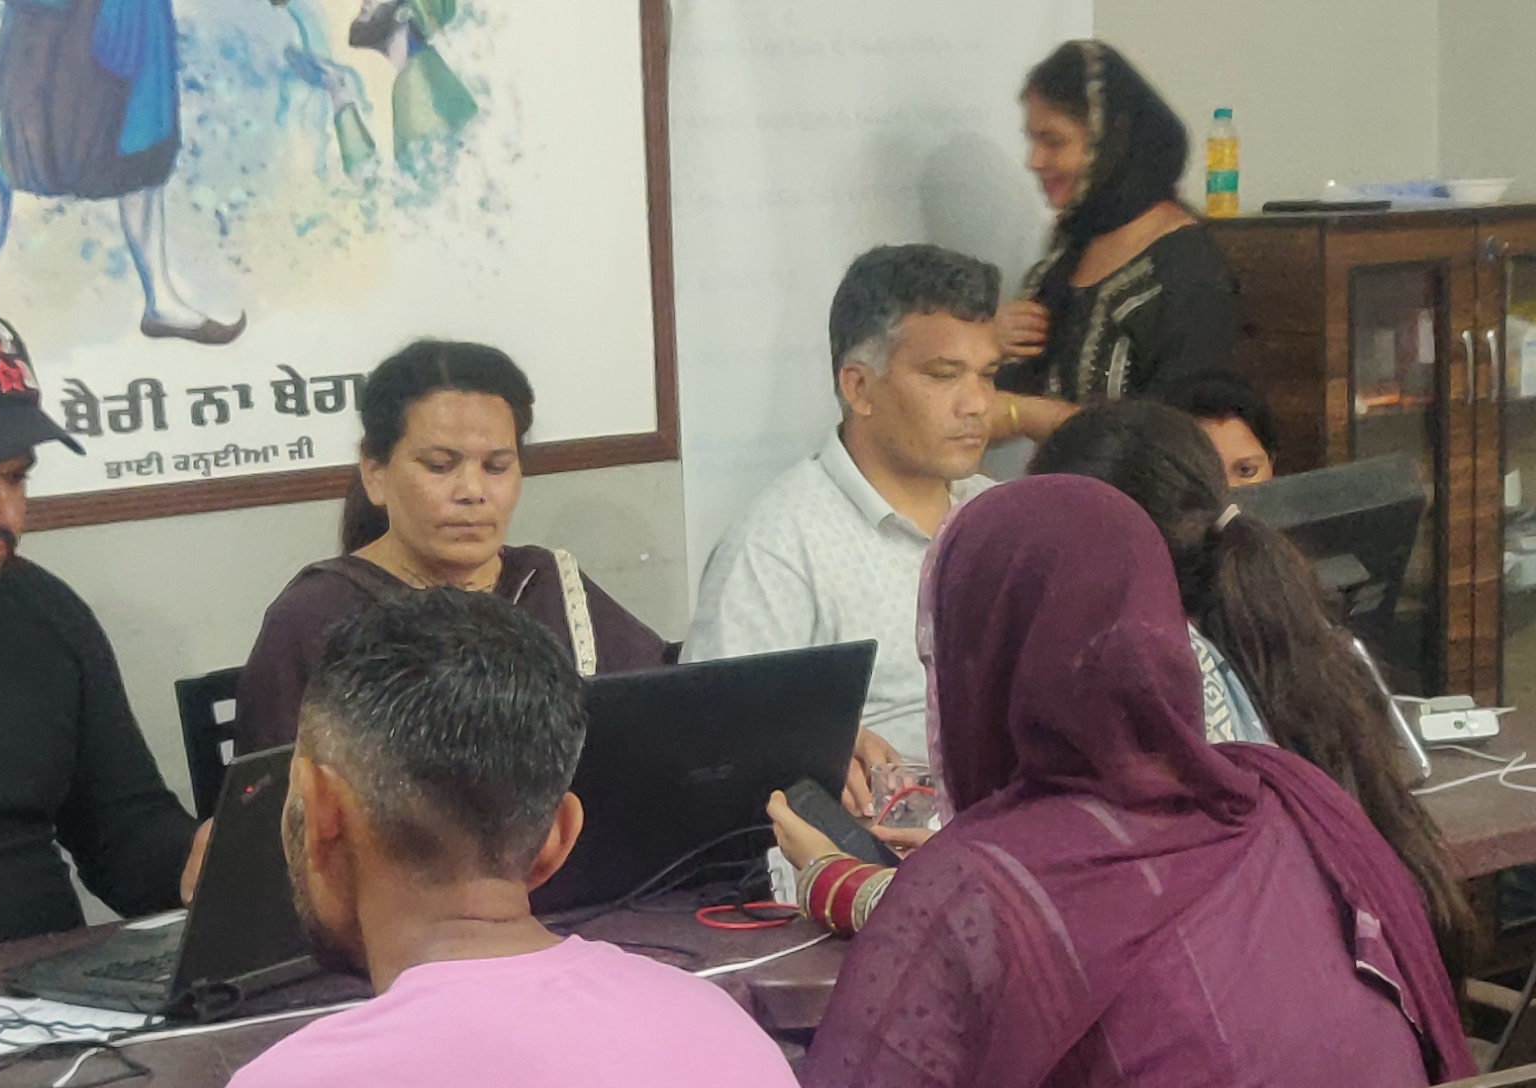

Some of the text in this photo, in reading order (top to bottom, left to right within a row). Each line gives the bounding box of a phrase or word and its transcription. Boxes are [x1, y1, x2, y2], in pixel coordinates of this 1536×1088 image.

[60, 377, 169, 437] ਬੈਰੀ
[185, 382, 255, 427] ਨਾ
[104, 451, 165, 479] ਭਾਈ
[286, 435, 315, 461] ਜੀ
